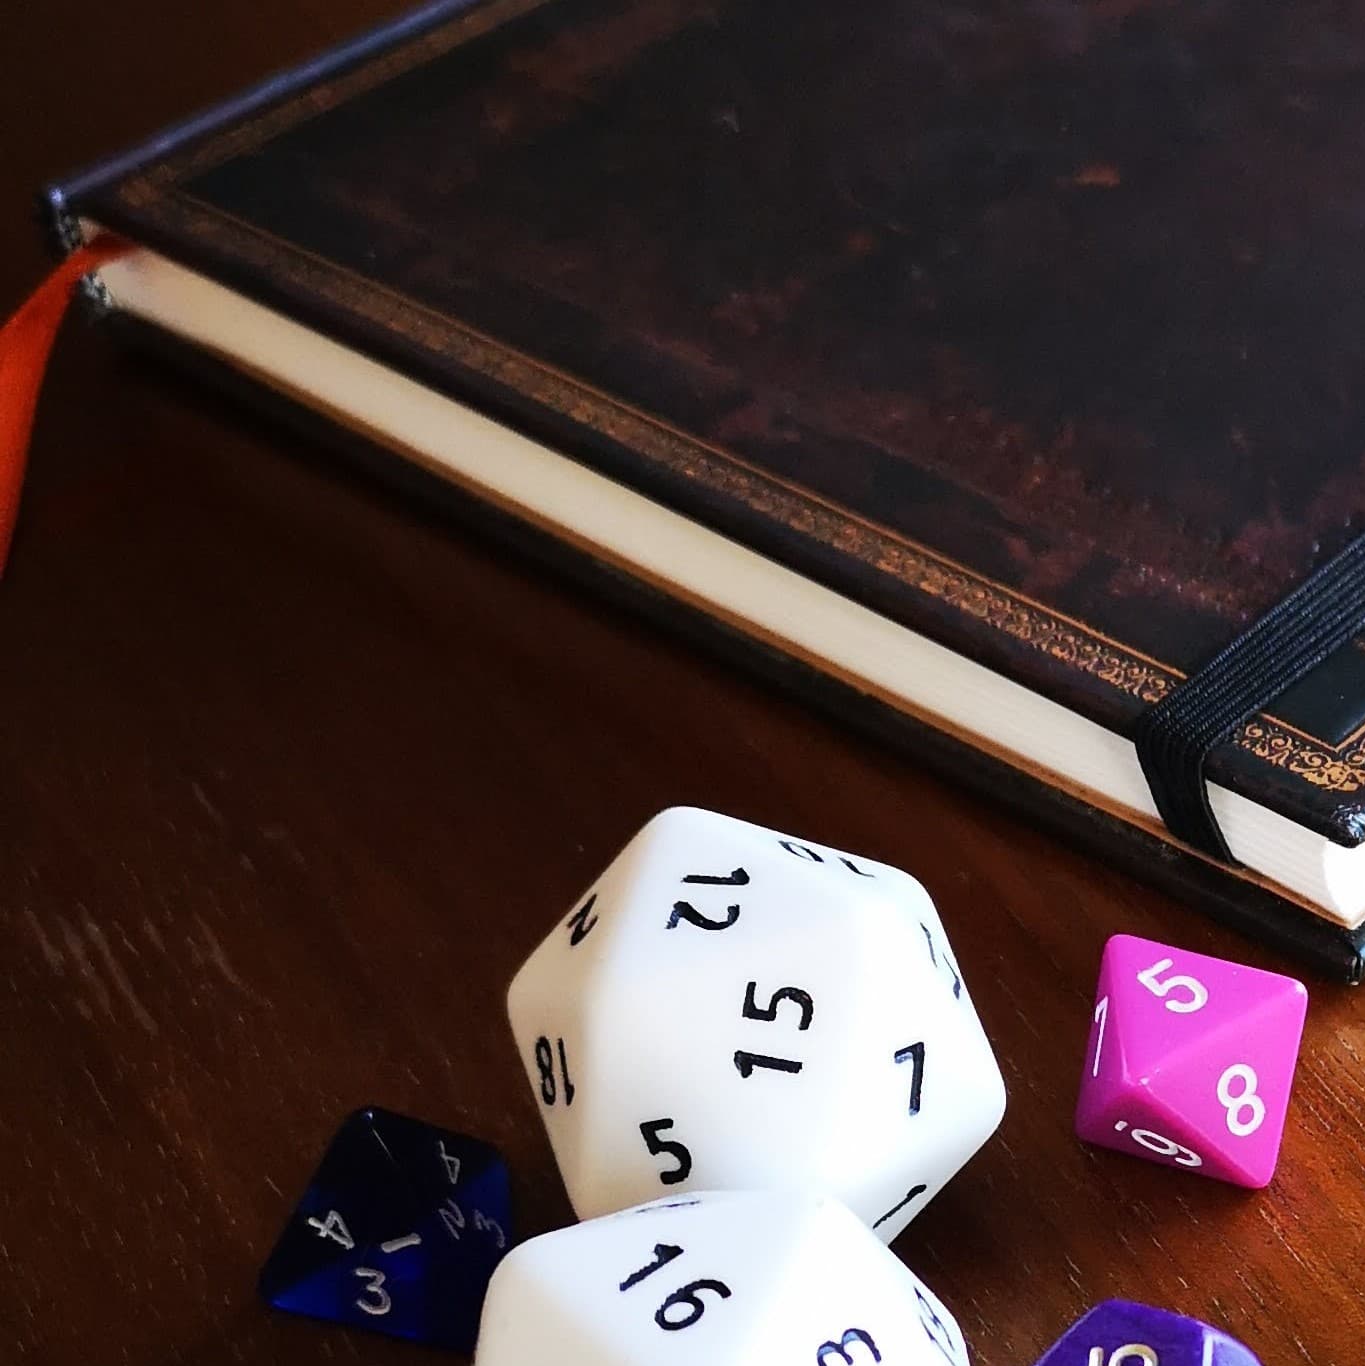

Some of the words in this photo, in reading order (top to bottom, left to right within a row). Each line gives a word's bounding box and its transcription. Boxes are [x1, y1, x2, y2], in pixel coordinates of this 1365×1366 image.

[565, 894, 598, 946] 2
[664, 867, 750, 930] 12
[1137, 958, 1208, 1013] 5
[733, 981, 814, 1078] 15
[534, 1036, 576, 1106] 18
[894, 1042, 925, 1116] 7
[1216, 1063, 1266, 1137] 8
[639, 1118, 693, 1185] 5
[307, 1209, 355, 1250] 4
[353, 1267, 392, 1315] 3
[620, 1243, 732, 1331] 16
